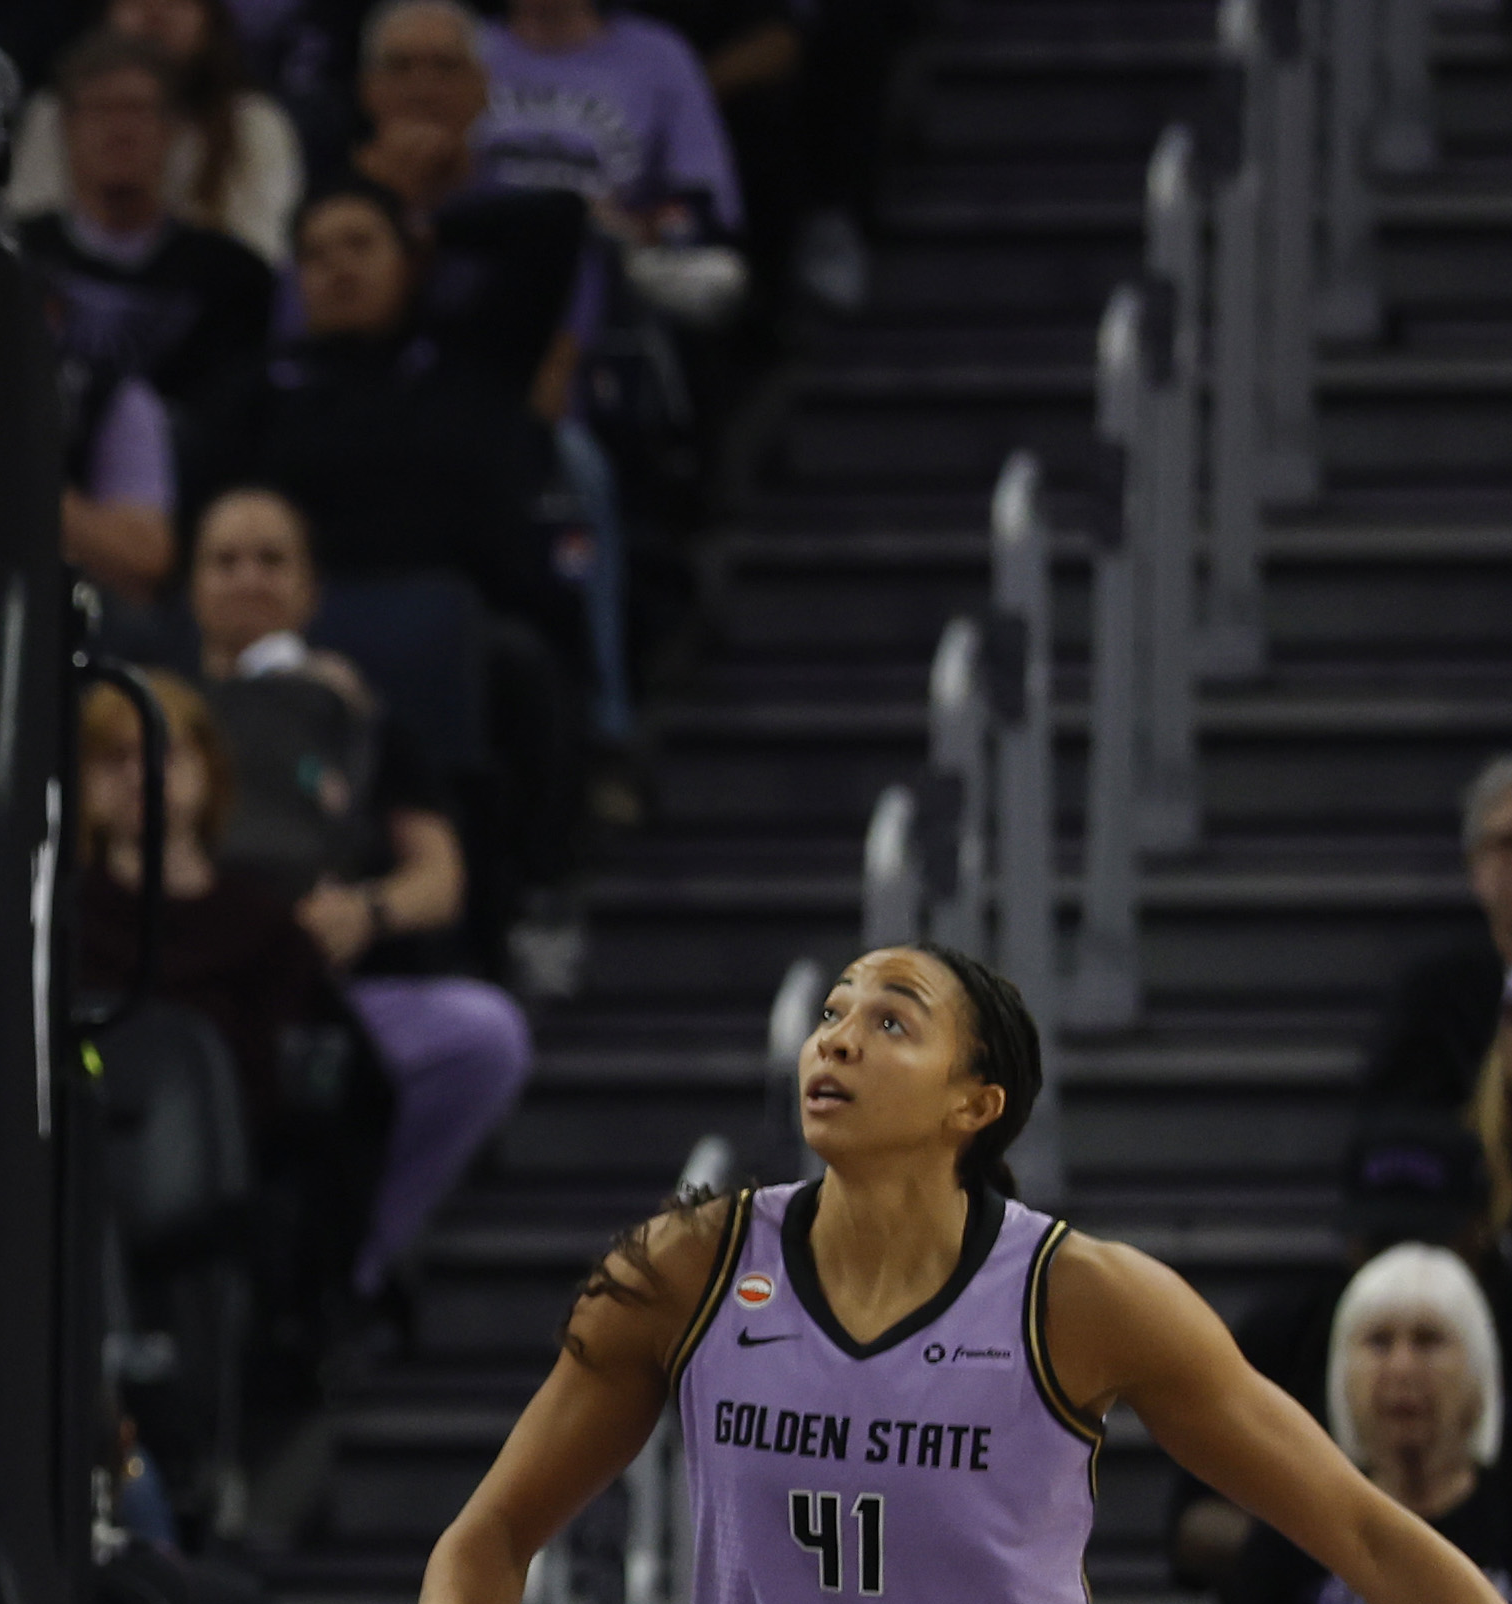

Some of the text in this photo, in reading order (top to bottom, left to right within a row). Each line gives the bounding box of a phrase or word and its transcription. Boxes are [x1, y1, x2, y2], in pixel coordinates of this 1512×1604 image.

[714, 1400, 991, 1471] GOLDEN STATE
[788, 1489, 884, 1597] 41
